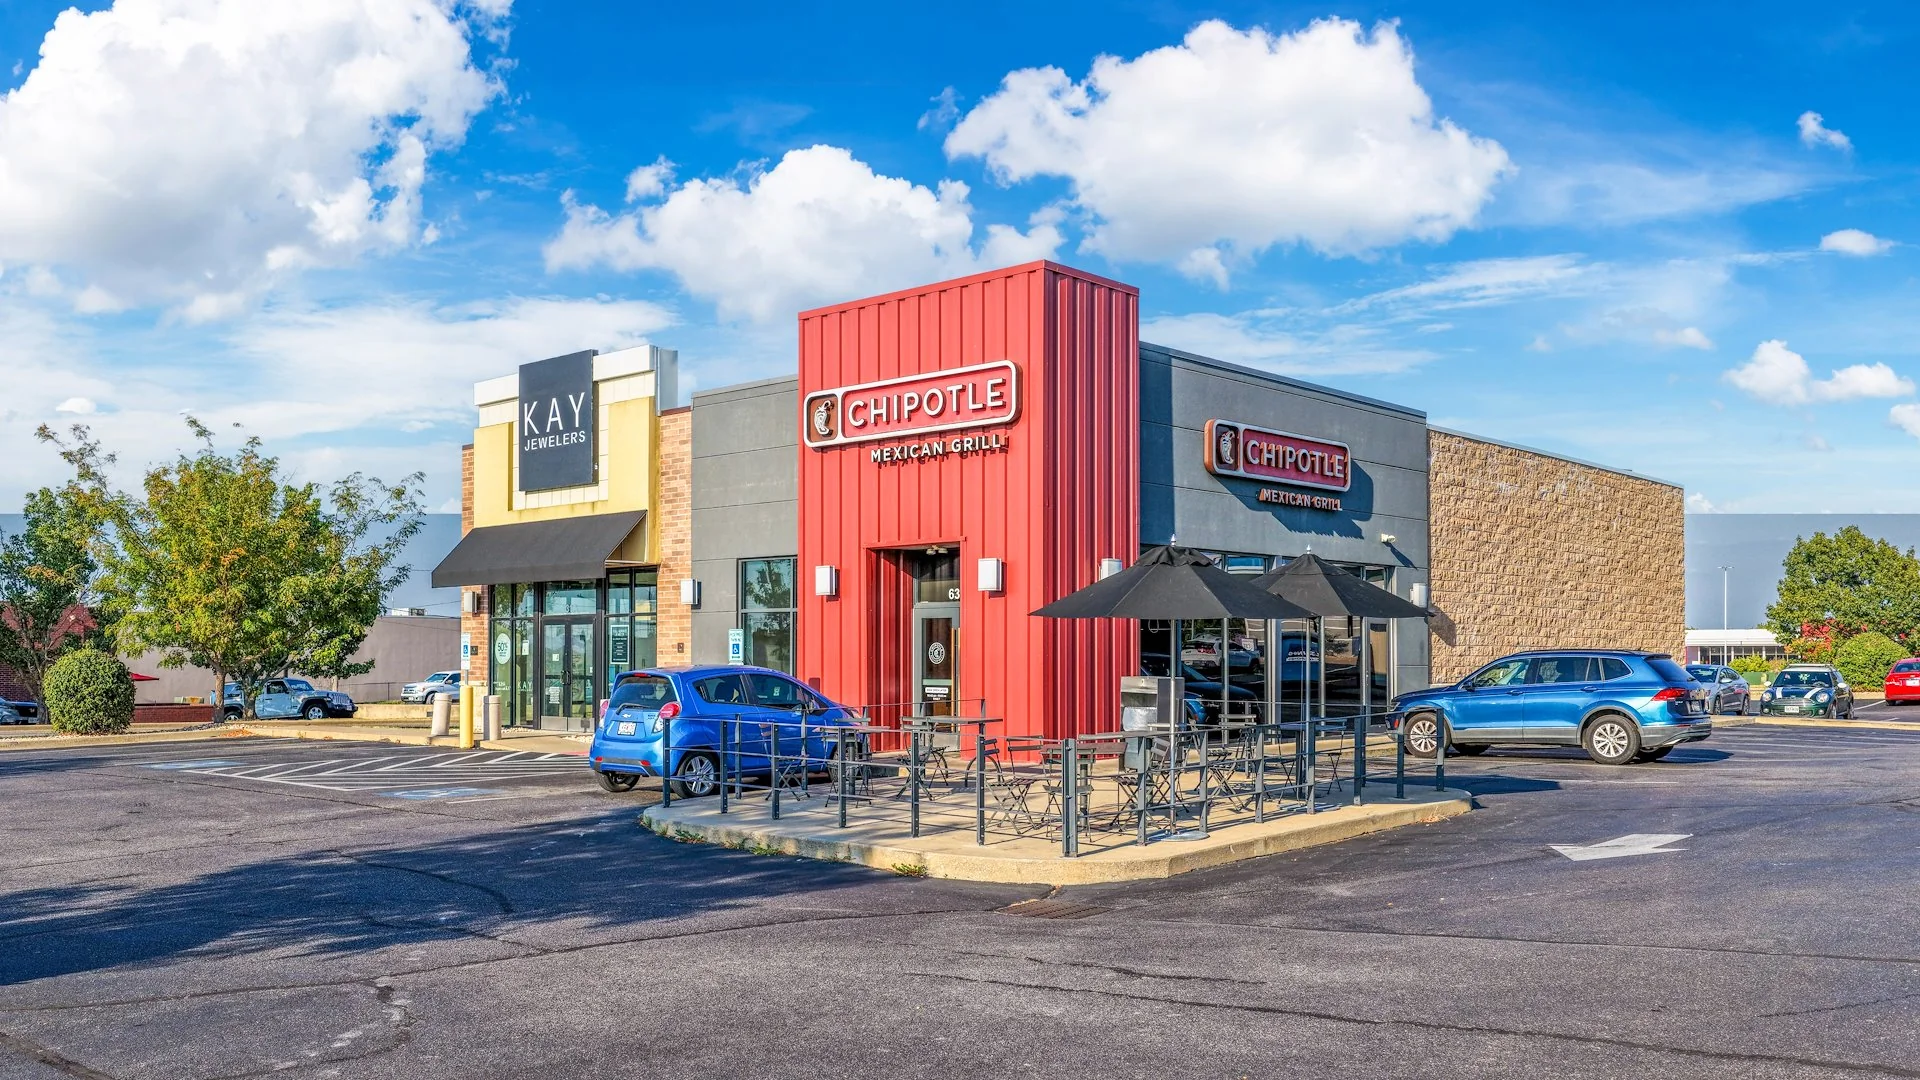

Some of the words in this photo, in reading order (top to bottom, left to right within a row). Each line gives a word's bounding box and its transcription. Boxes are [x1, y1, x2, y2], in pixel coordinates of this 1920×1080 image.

[524, 392, 585, 436] KAY
[848, 378, 1006, 426] CHIPOTLE
[524, 430, 586, 451] JEWELERS
[870, 441, 944, 463] MEXICAN
[951, 433, 1002, 453] GRILL
[1246, 439, 1344, 477] CHIPOTLE
[1260, 488, 1310, 507] MEXICAN
[1314, 497, 1343, 511] GRILL
[948, 587, 960, 600] 63
[517, 681, 533, 689] KAY
